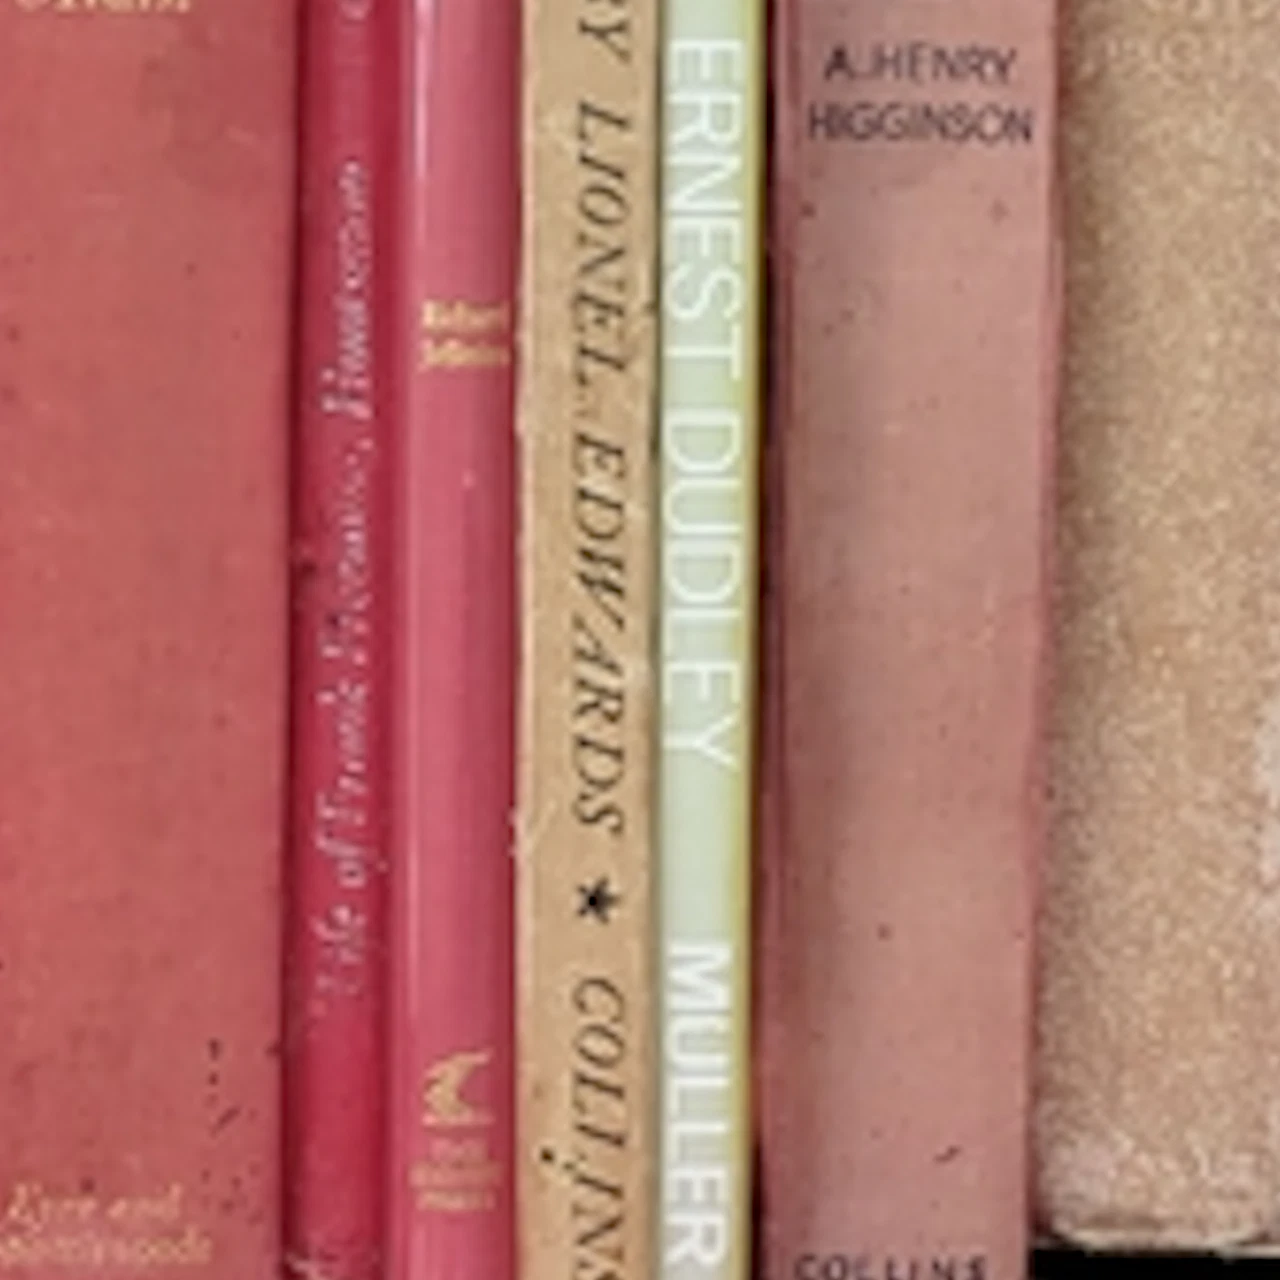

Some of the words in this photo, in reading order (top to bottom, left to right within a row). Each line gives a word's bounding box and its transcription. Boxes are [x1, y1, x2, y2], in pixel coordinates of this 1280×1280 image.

[572, 100, 632, 380] LIONEL
[663, 37, 745, 381] ERNEST
[808, 100, 1036, 147] HIGGINSON
[571, 432, 628, 838] EDWARDS
[662, 410, 743, 774] DUDLEY
[661, 943, 734, 1270] MULLER
